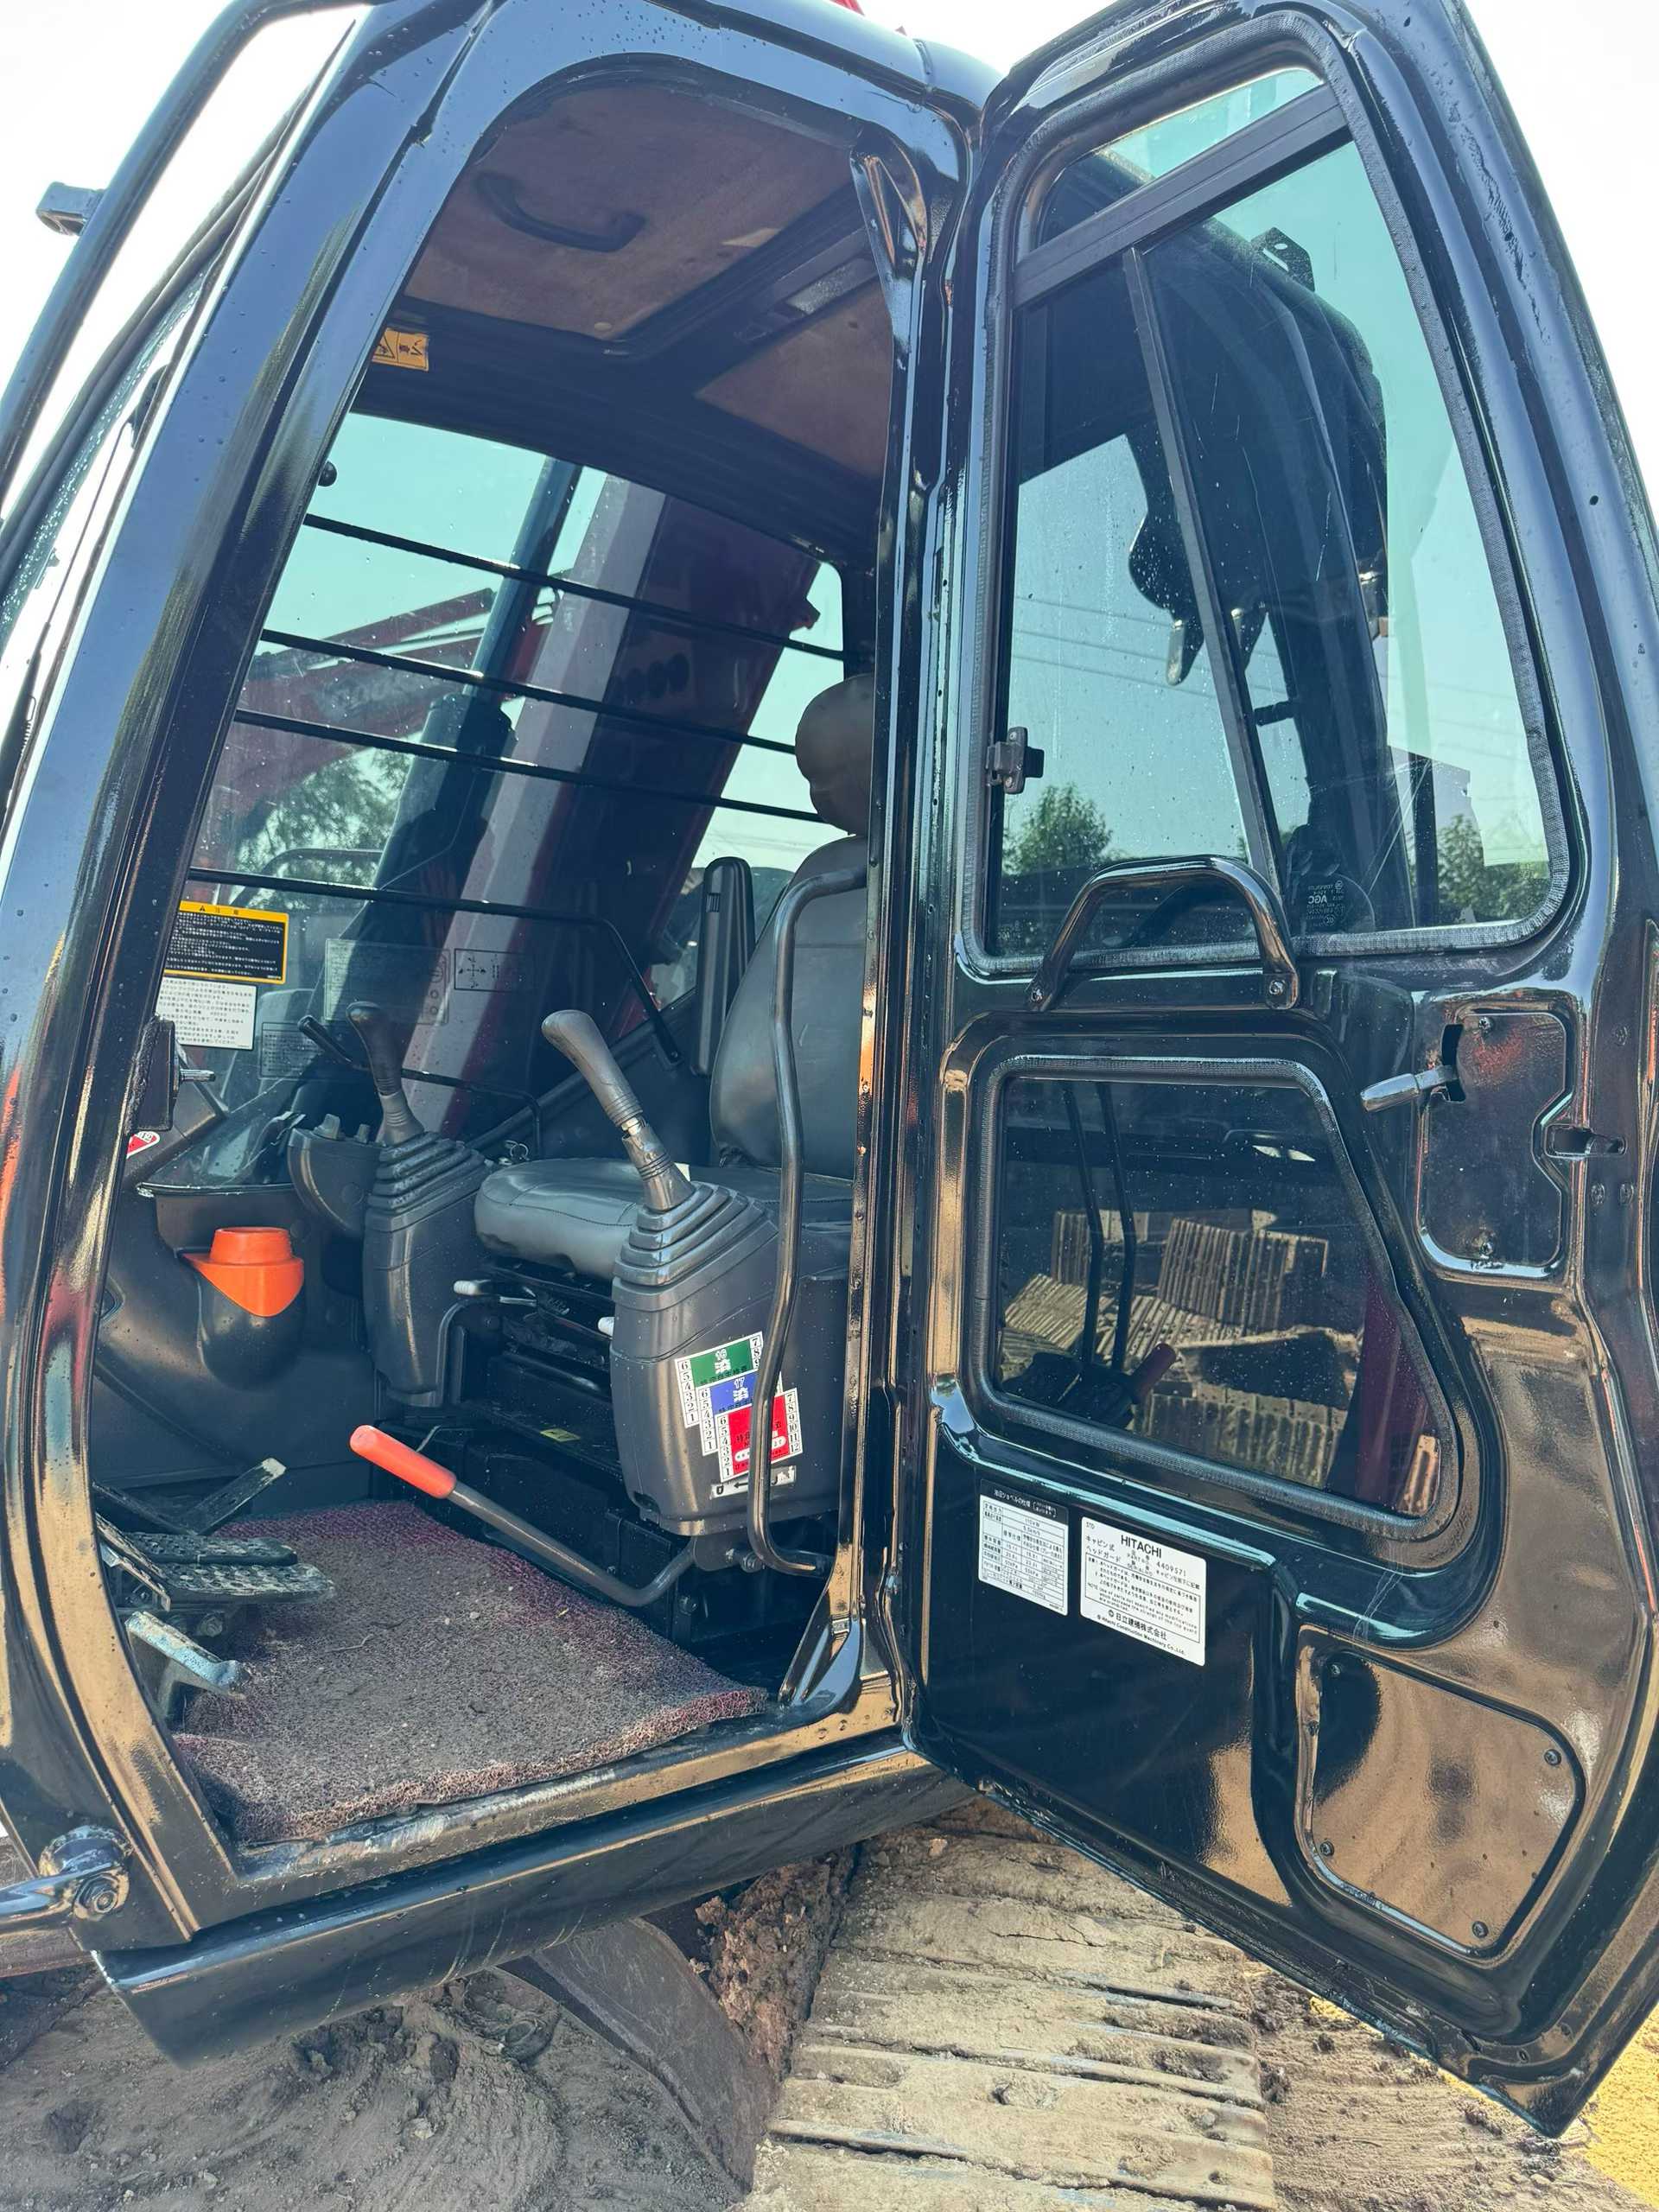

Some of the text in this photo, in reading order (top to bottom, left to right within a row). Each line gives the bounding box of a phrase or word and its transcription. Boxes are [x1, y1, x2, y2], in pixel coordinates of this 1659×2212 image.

[752, 1338, 760, 1347] 7
[715, 1349, 727, 1361] 16
[753, 1348, 760, 1357] 8
[680, 1361, 689, 1370] 6
[683, 1372, 690, 1382] 5
[684, 1382, 691, 1391] 4
[734, 1376, 746, 1389] 17
[685, 1391, 693, 1402] 3
[701, 1389, 709, 1398] 6
[687, 1402, 695, 1412] 2
[702, 1399, 710, 1408] 5
[703, 1409, 711, 1419] 4
[704, 1420, 712, 1429] 3
[720, 1417, 727, 1426] 6
[787, 1394, 800, 1452] 7 8 9 10 11 12
[706, 1430, 713, 1440] 2
[721, 1427, 728, 1438] 5
[721, 1439, 728, 1448] 4
[722, 1447, 730, 1458] 3
[723, 1458, 730, 1467] 2
[1121, 1535, 1161, 1558] HITACHI
[1156, 1560, 1185, 1577] 4409571
[1116, 1613, 1166, 1640] 日立建機株式会社
